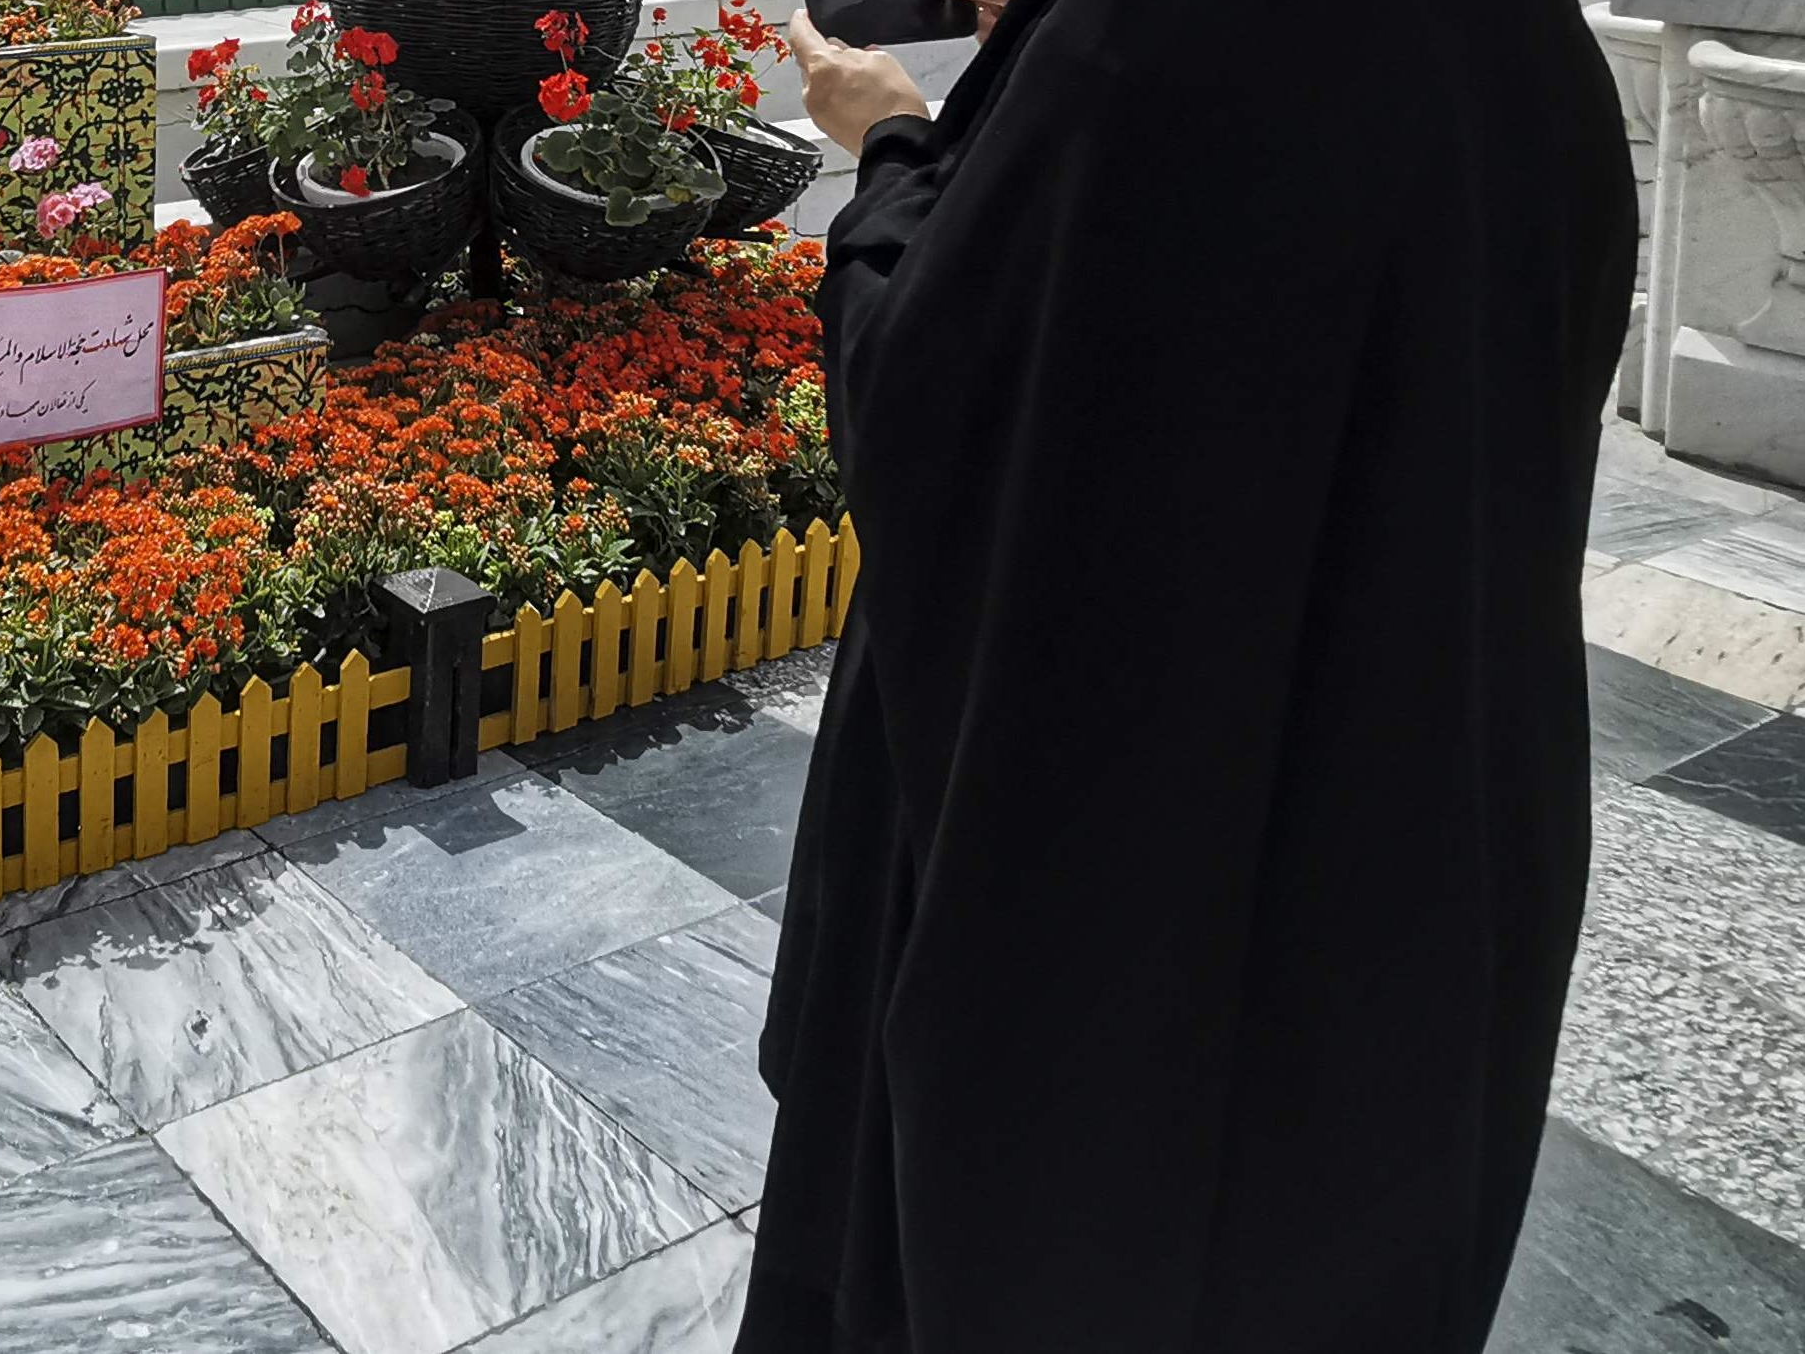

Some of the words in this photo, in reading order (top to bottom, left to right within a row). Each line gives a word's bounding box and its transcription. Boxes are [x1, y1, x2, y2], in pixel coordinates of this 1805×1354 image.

[81, 314, 134, 354] شهادت
[123, 321, 154, 358] محل
[75, 379, 96, 414] یکی
